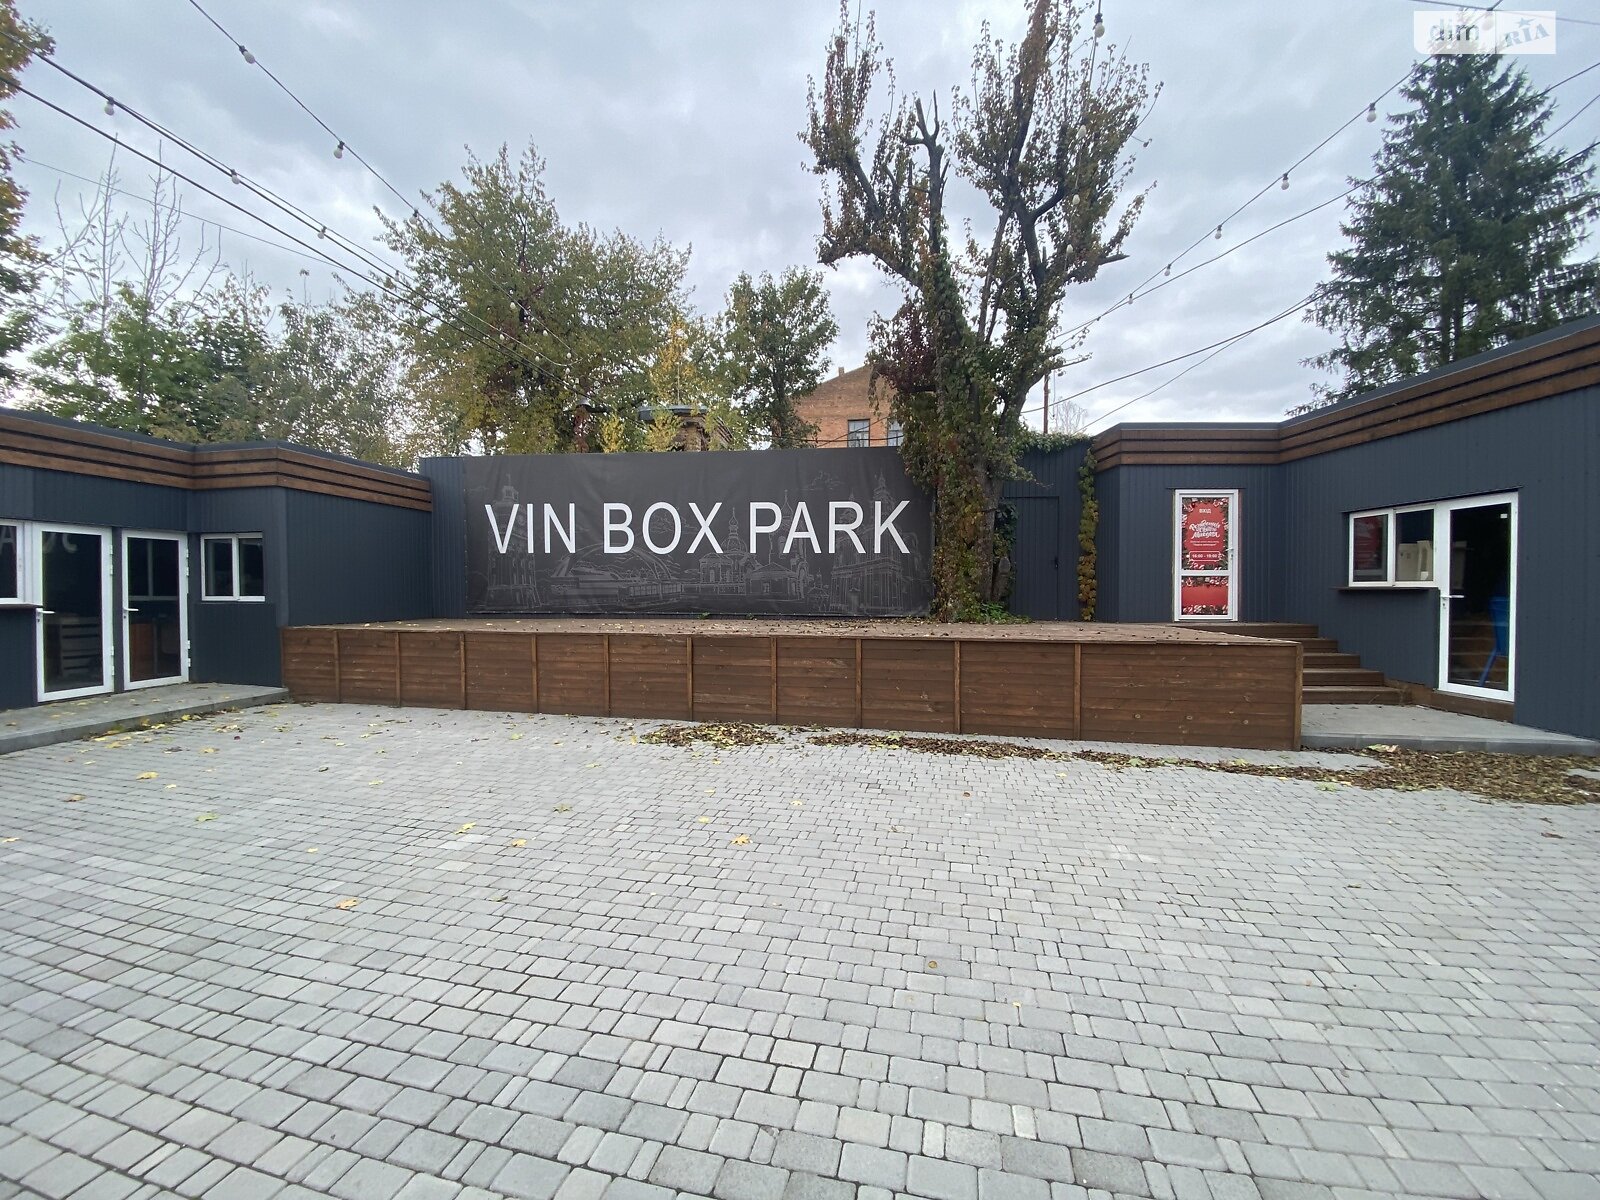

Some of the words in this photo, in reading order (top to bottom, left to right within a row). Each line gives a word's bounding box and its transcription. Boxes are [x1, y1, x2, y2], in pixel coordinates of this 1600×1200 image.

[484, 503, 576, 554] VIN
[603, 501, 723, 554] BOX
[749, 500, 910, 554] PARK
